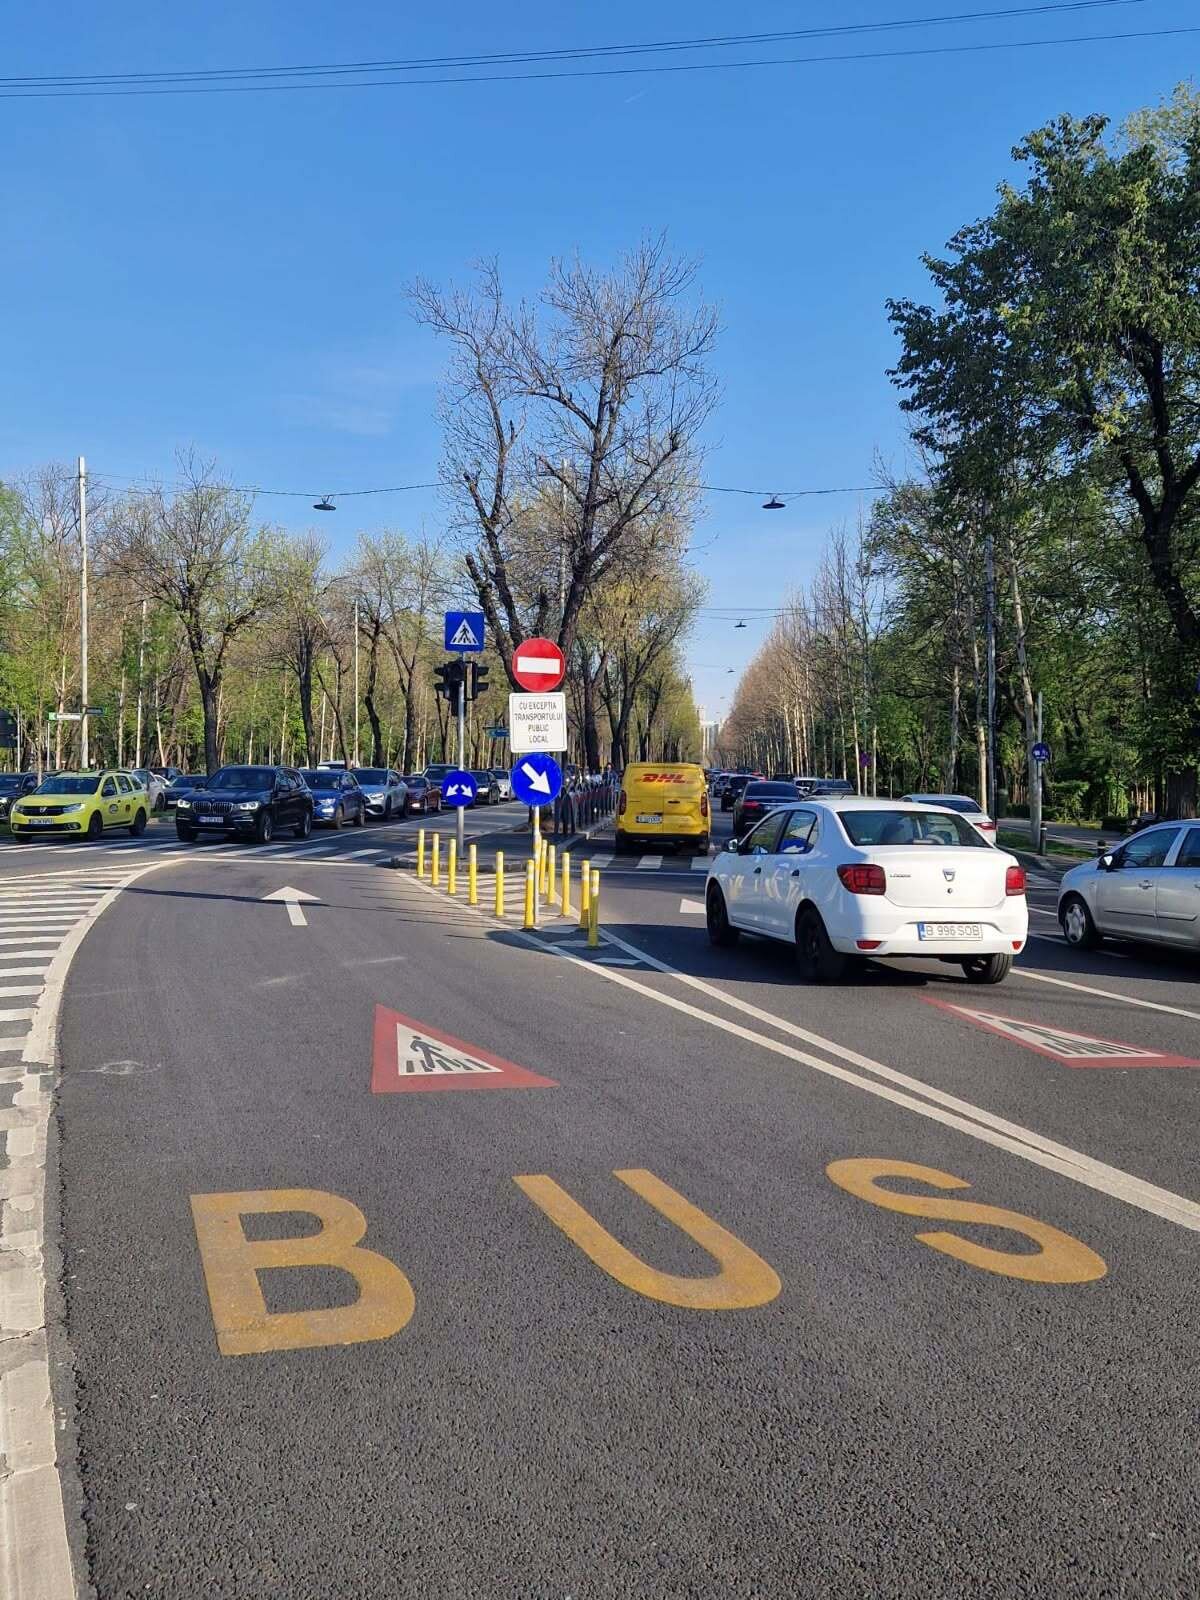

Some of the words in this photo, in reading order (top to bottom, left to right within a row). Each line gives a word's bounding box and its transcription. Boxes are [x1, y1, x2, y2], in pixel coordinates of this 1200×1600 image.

[519, 701, 527, 710] CU
[514, 712, 563, 721] TRANSPORTULUI
[528, 724, 549, 732] PUBLIC
[528, 735, 549, 744] LOCAL
[641, 773, 686, 784] DHL
[926, 925, 934, 936] B
[190, 1158, 1107, 1355] BUS
